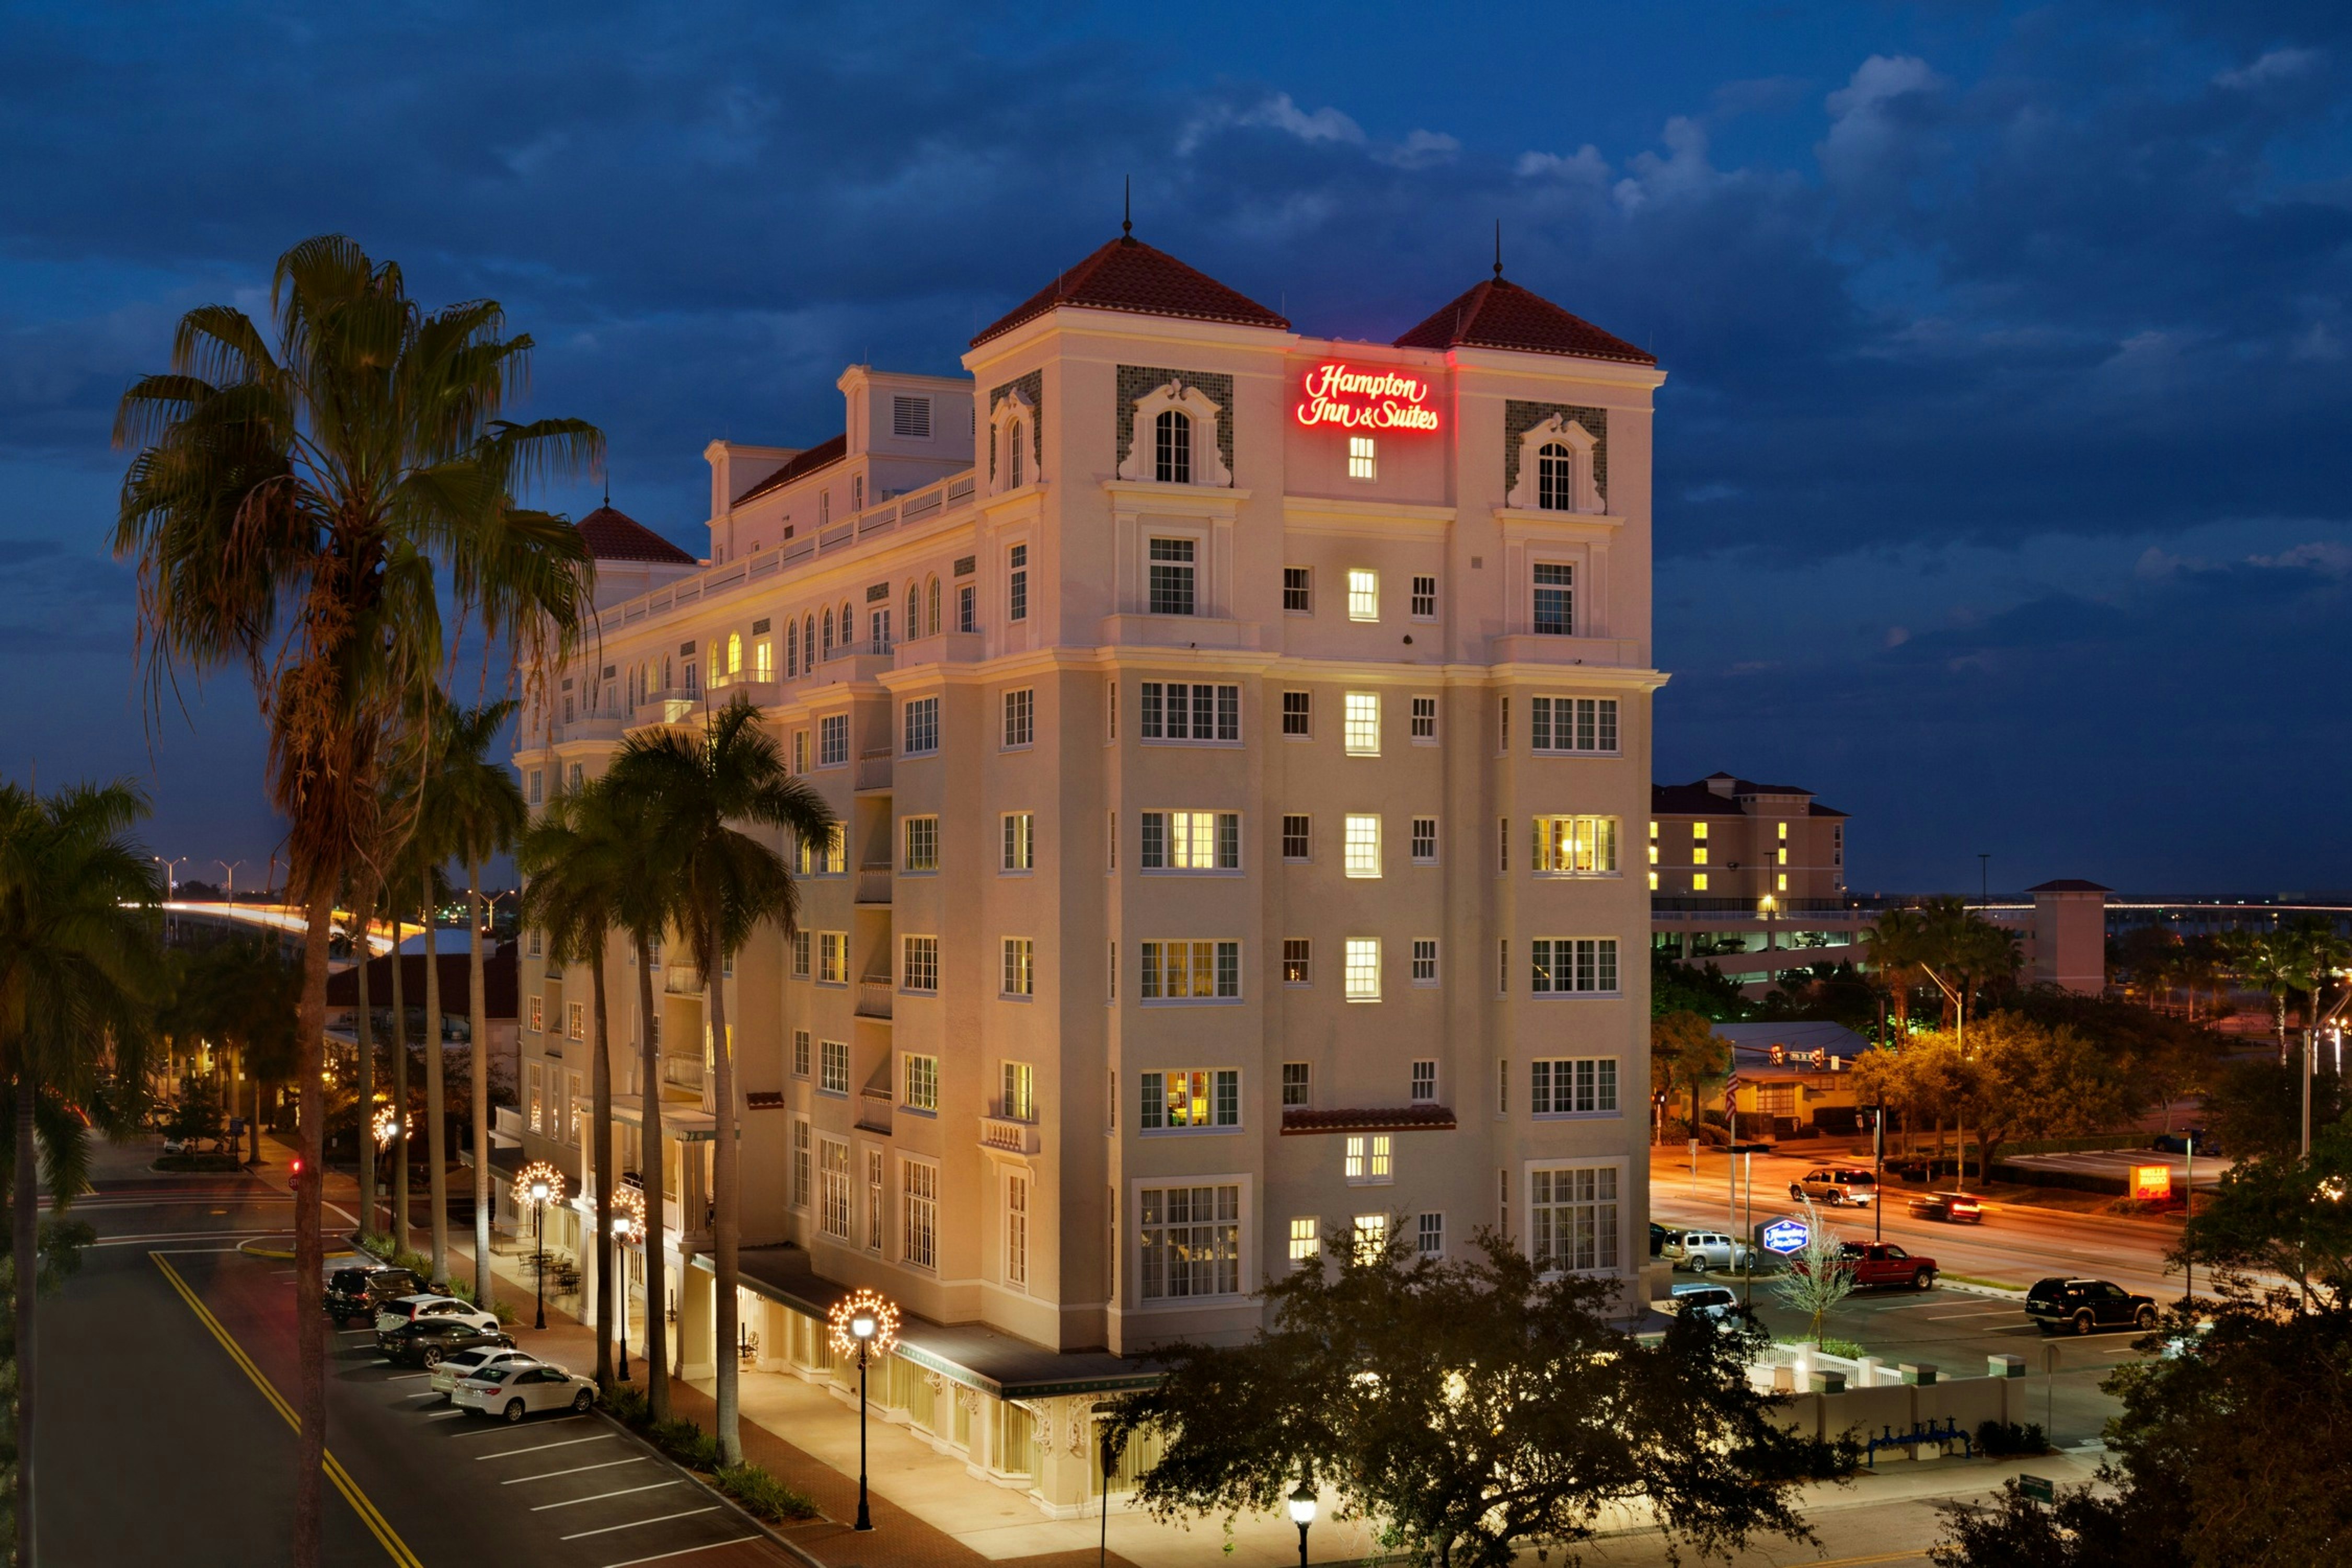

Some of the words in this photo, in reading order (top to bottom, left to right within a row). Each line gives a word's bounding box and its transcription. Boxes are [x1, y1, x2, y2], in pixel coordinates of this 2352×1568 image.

[1306, 365, 1427, 402] Hampton
[1298, 397, 1360, 427] Inn
[1359, 407, 1376, 428] &
[1374, 400, 1438, 430] Suites
